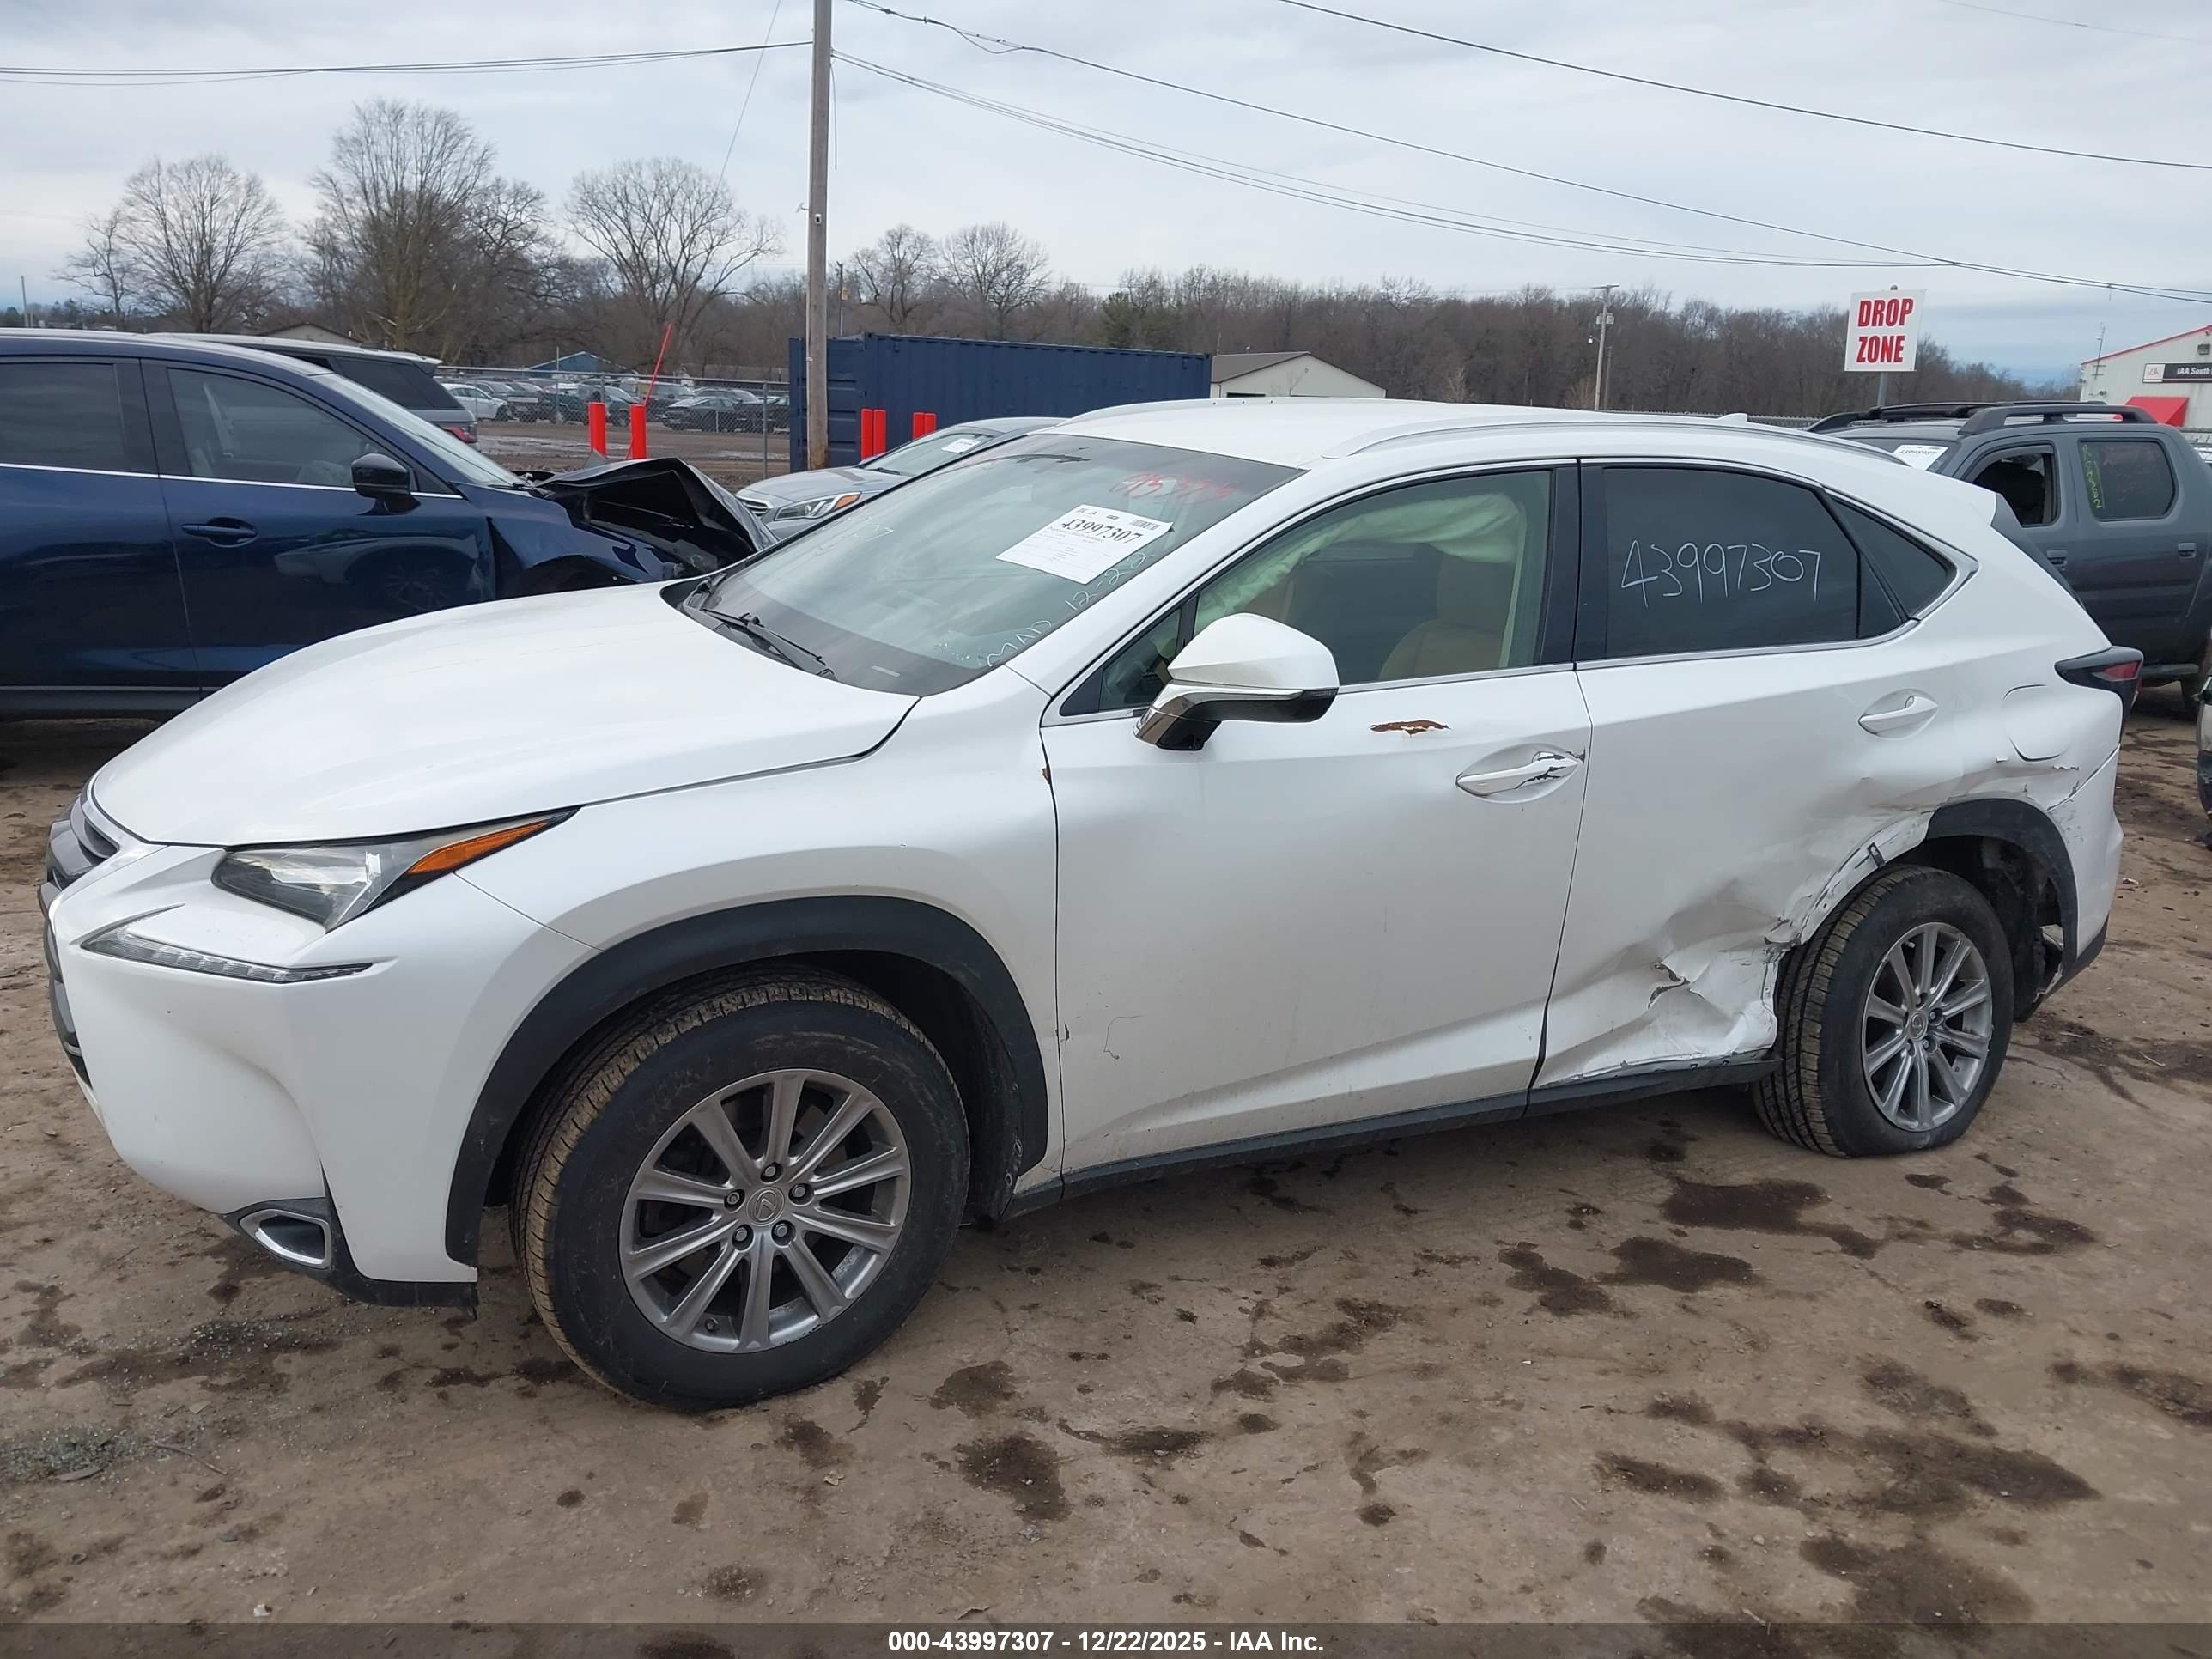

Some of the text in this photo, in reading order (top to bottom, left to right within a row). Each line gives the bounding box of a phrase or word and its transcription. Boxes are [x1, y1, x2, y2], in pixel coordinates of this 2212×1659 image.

[1857, 298, 1914, 327] DROP
[1856, 335, 1905, 363] ZONE
[2177, 367, 2211, 375] IAA South
[1061, 518, 1144, 544] 43997307
[1620, 539, 1821, 608] 43997307
